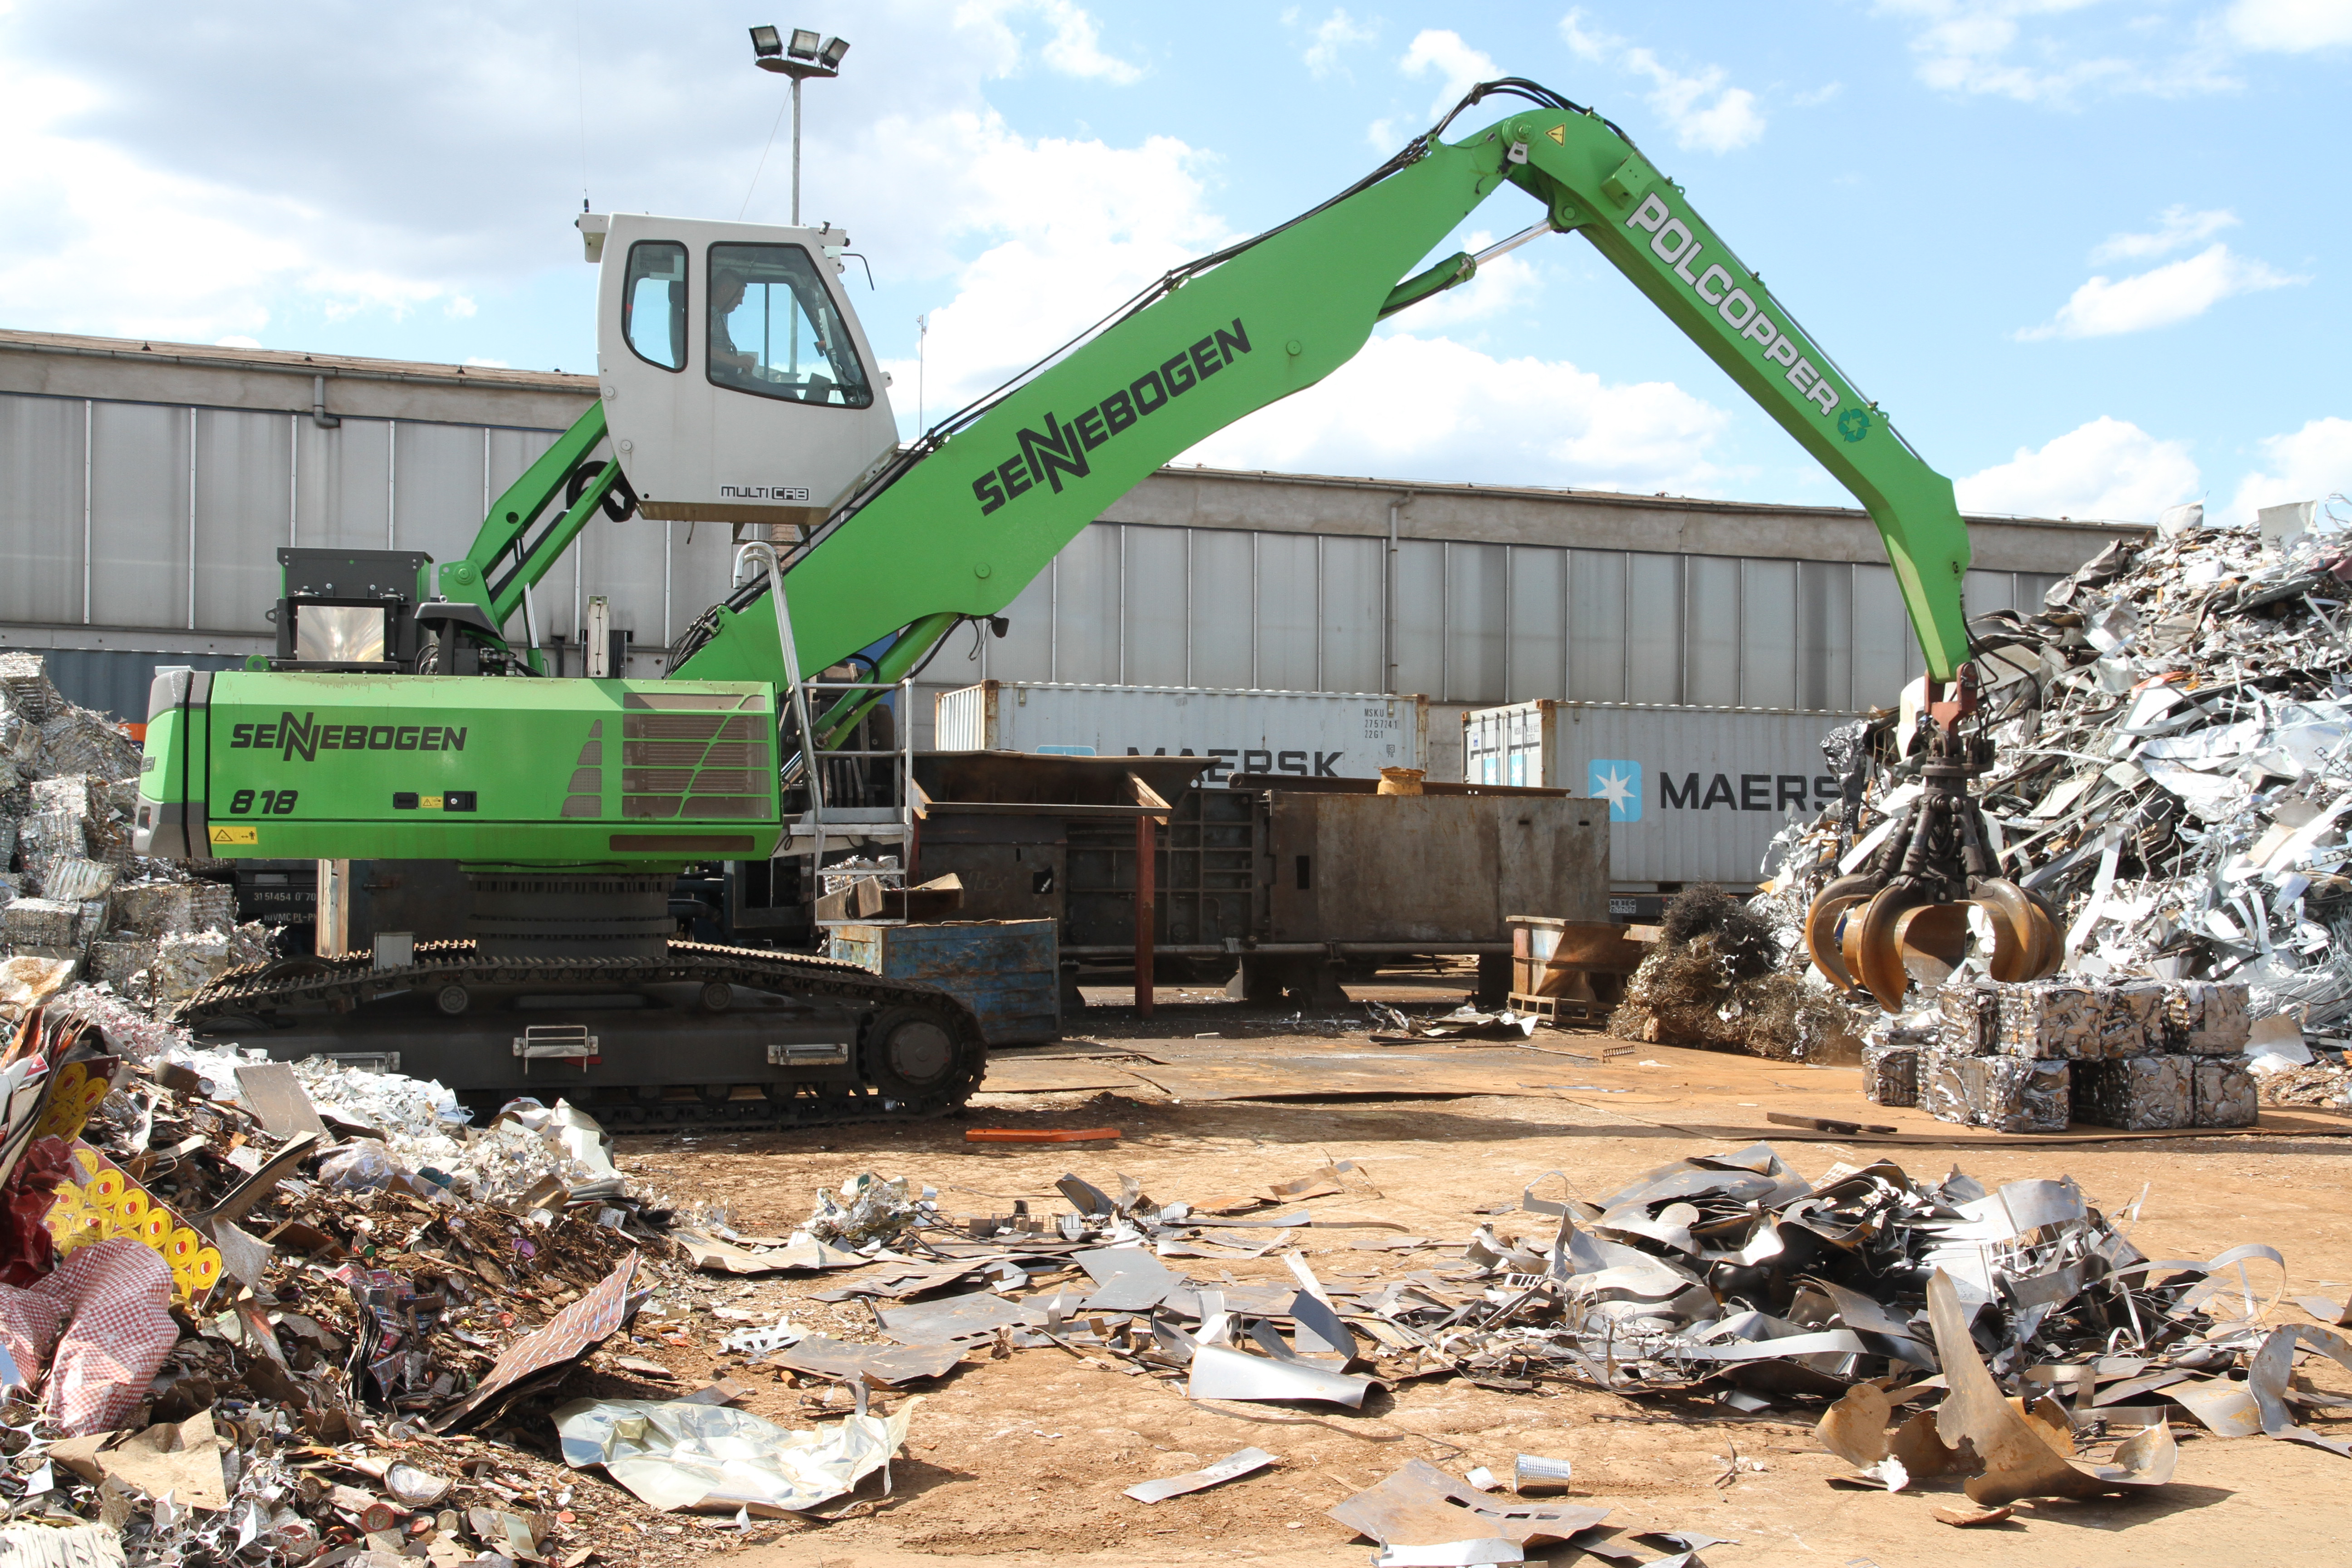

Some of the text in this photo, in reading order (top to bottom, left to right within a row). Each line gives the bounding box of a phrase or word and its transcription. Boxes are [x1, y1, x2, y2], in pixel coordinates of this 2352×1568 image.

[1624, 191, 1841, 416] POLCOPPER
[972, 318, 1252, 516] SENNEBOGEN
[721, 486, 808, 500] MULTI CAB
[1364, 708, 1384, 717] MSKU
[1365, 720, 1397, 729] 2757241
[230, 711, 467, 762] SENNEBOGEN
[1365, 730, 1383, 738] 22G1
[1127, 747, 1344, 782] ERSK
[230, 789, 299, 814] 818
[1660, 772, 1869, 812] MAERS
